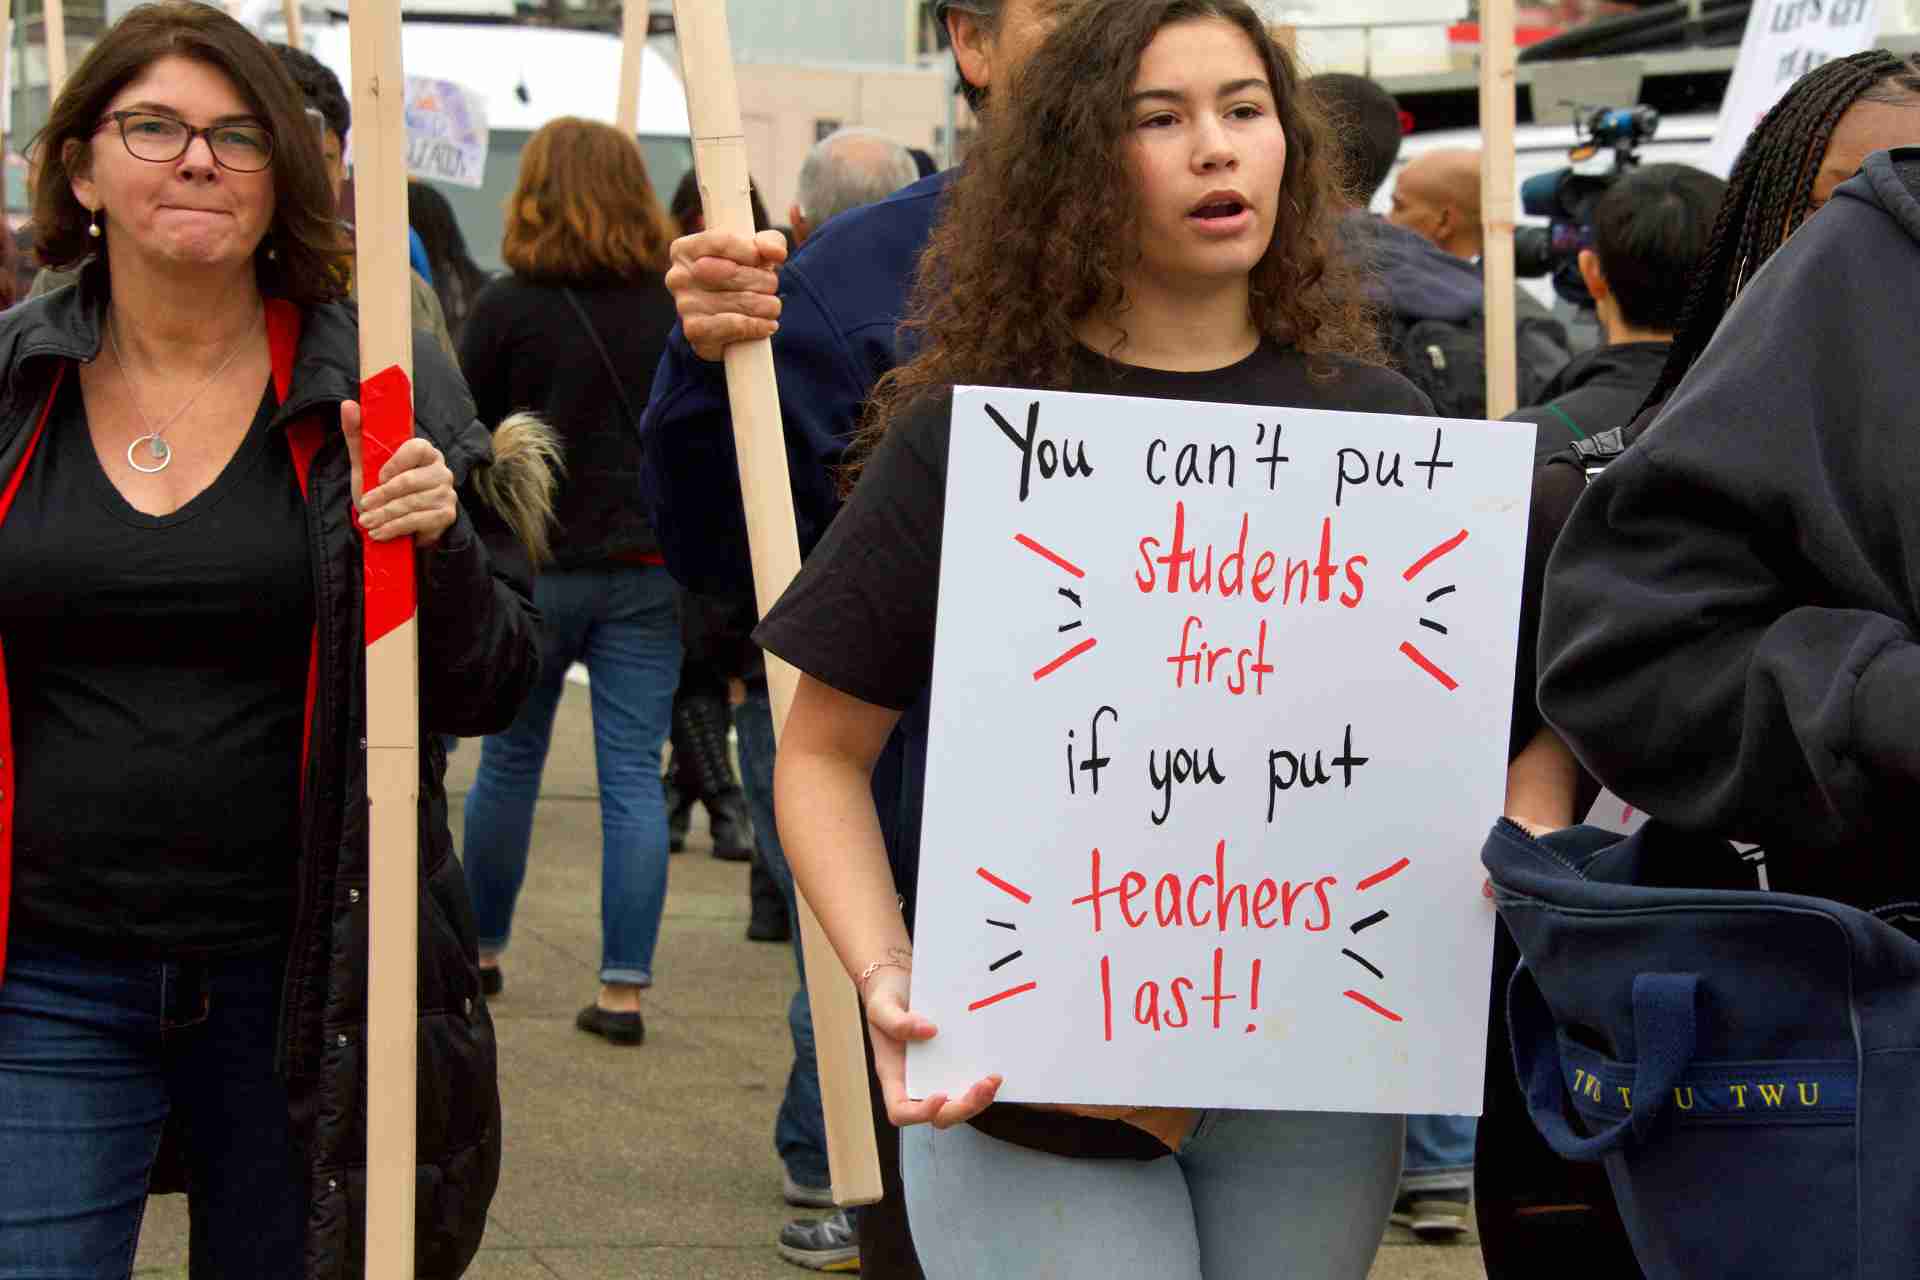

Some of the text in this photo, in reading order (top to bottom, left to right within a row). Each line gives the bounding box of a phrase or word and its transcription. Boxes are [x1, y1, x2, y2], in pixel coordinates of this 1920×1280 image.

[984, 401, 1454, 507] You can't put
[1135, 499, 1368, 609] students
[1167, 615, 1275, 695] first
[1067, 705, 1369, 826] if you put
[1071, 838, 1338, 933] teachers
[1100, 947, 1262, 1041] last!
[1729, 1082, 1820, 1109] TWU
